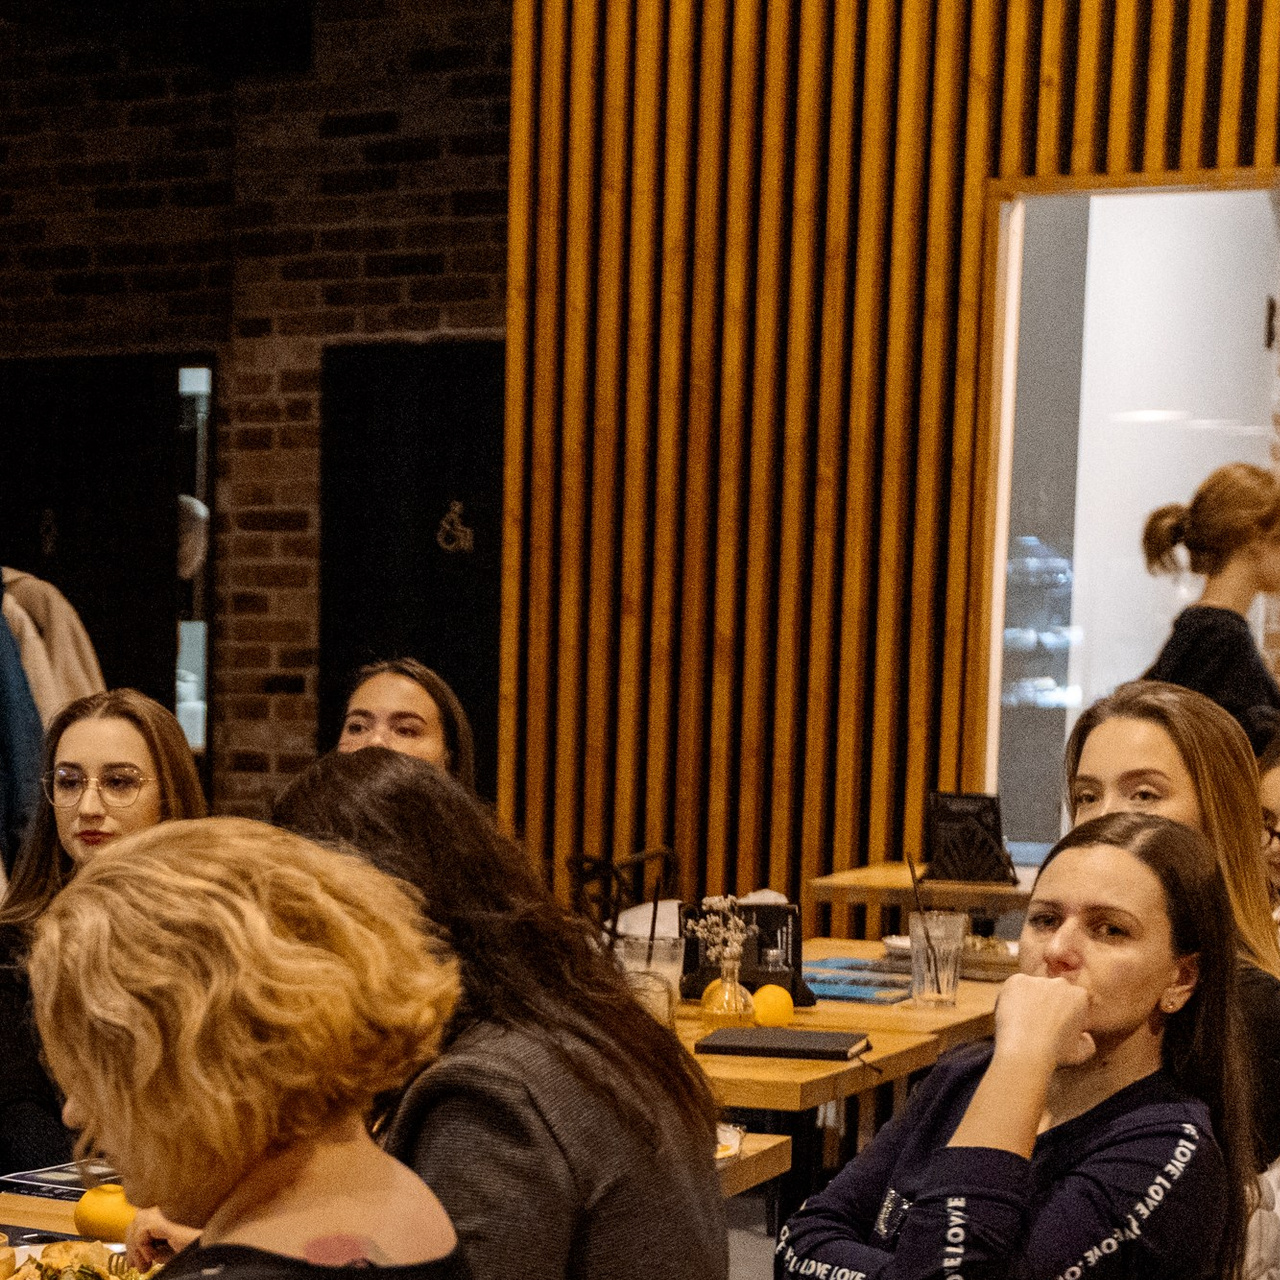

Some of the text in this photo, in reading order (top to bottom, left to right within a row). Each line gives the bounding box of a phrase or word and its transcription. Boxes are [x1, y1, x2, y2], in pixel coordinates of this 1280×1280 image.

[1163, 1138, 1197, 1180] LOVE
[1134, 1175, 1172, 1220] LOVE
[799, 1258, 832, 1280] LOVE
